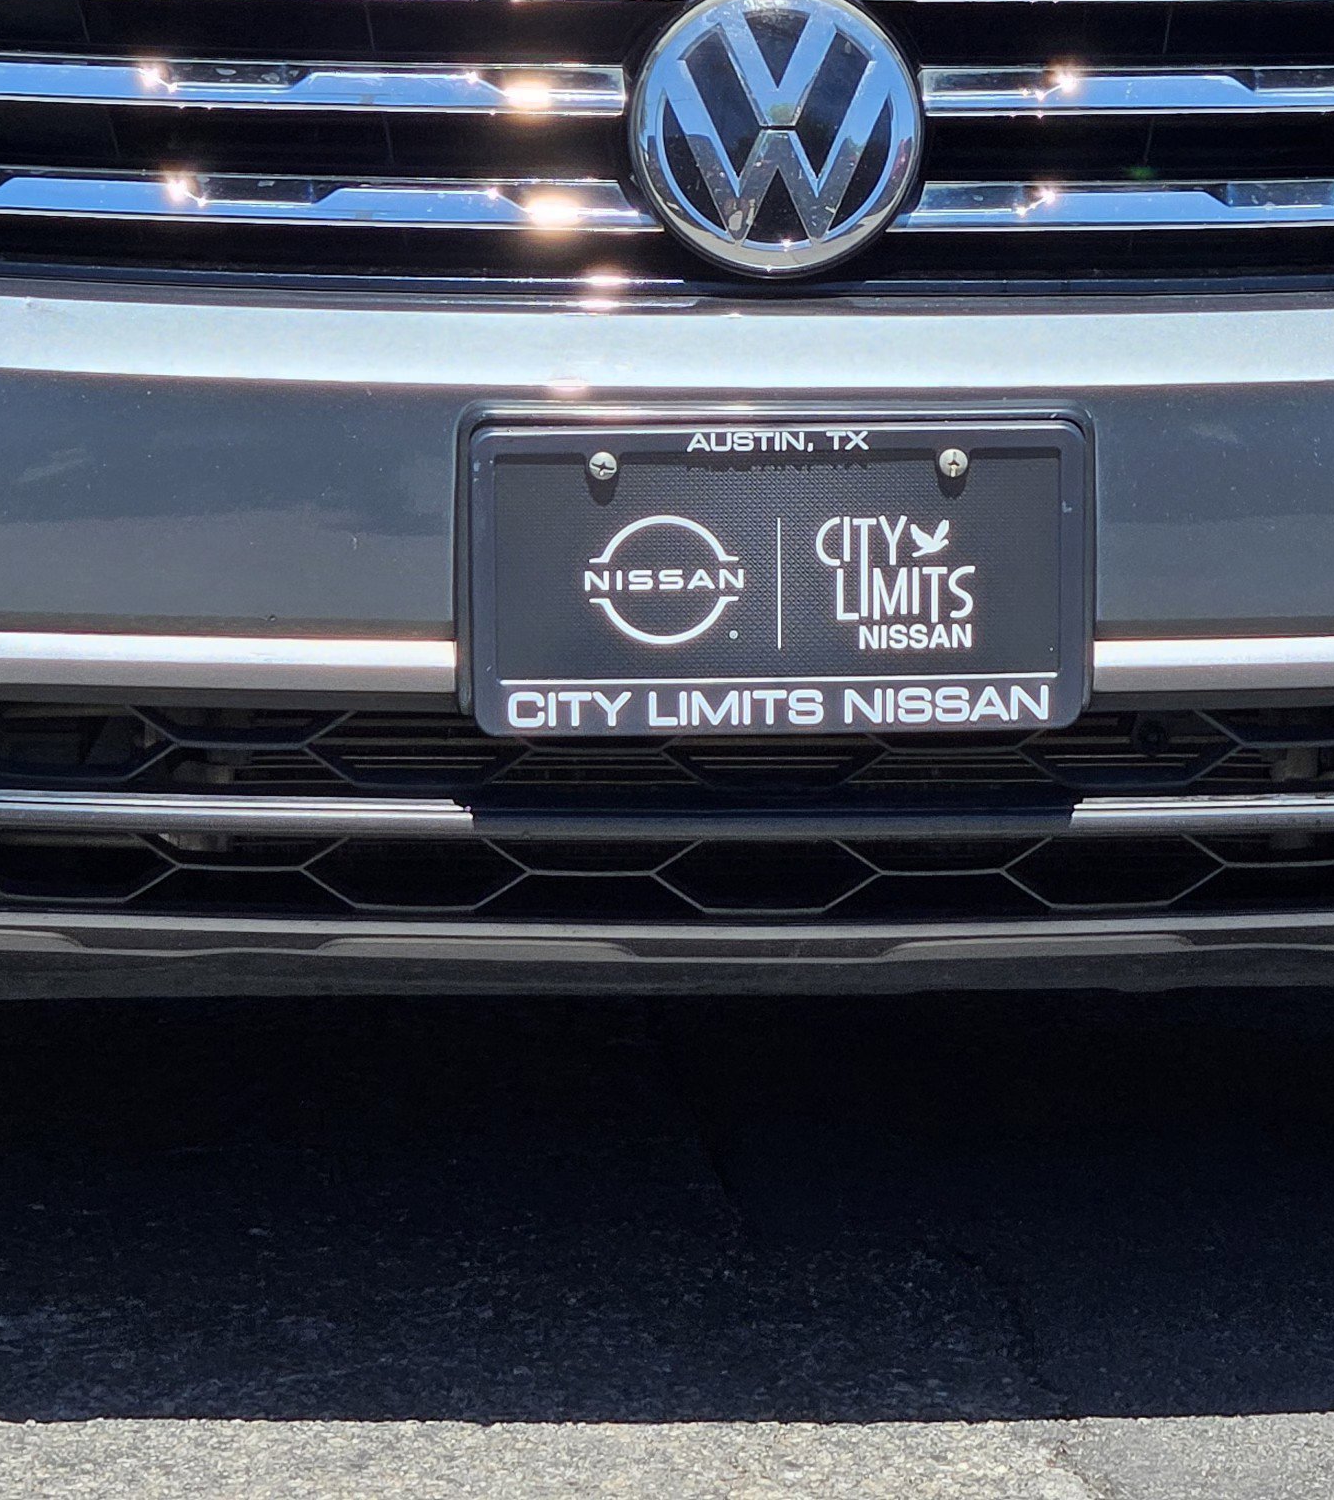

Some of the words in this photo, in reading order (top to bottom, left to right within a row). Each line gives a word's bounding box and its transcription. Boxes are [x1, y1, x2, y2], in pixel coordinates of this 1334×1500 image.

[657, 0, 901, 245] VW
[686, 431, 814, 453] AUSTIN,
[826, 431, 870, 452] TX
[816, 515, 907, 566] CITY
[584, 570, 745, 591] NISSAN
[836, 565, 976, 623] LIMITS
[859, 624, 972, 649] NISSAN
[507, 691, 632, 729] CITY
[648, 689, 823, 727] LIMITS
[843, 685, 1050, 725] NISSAN
